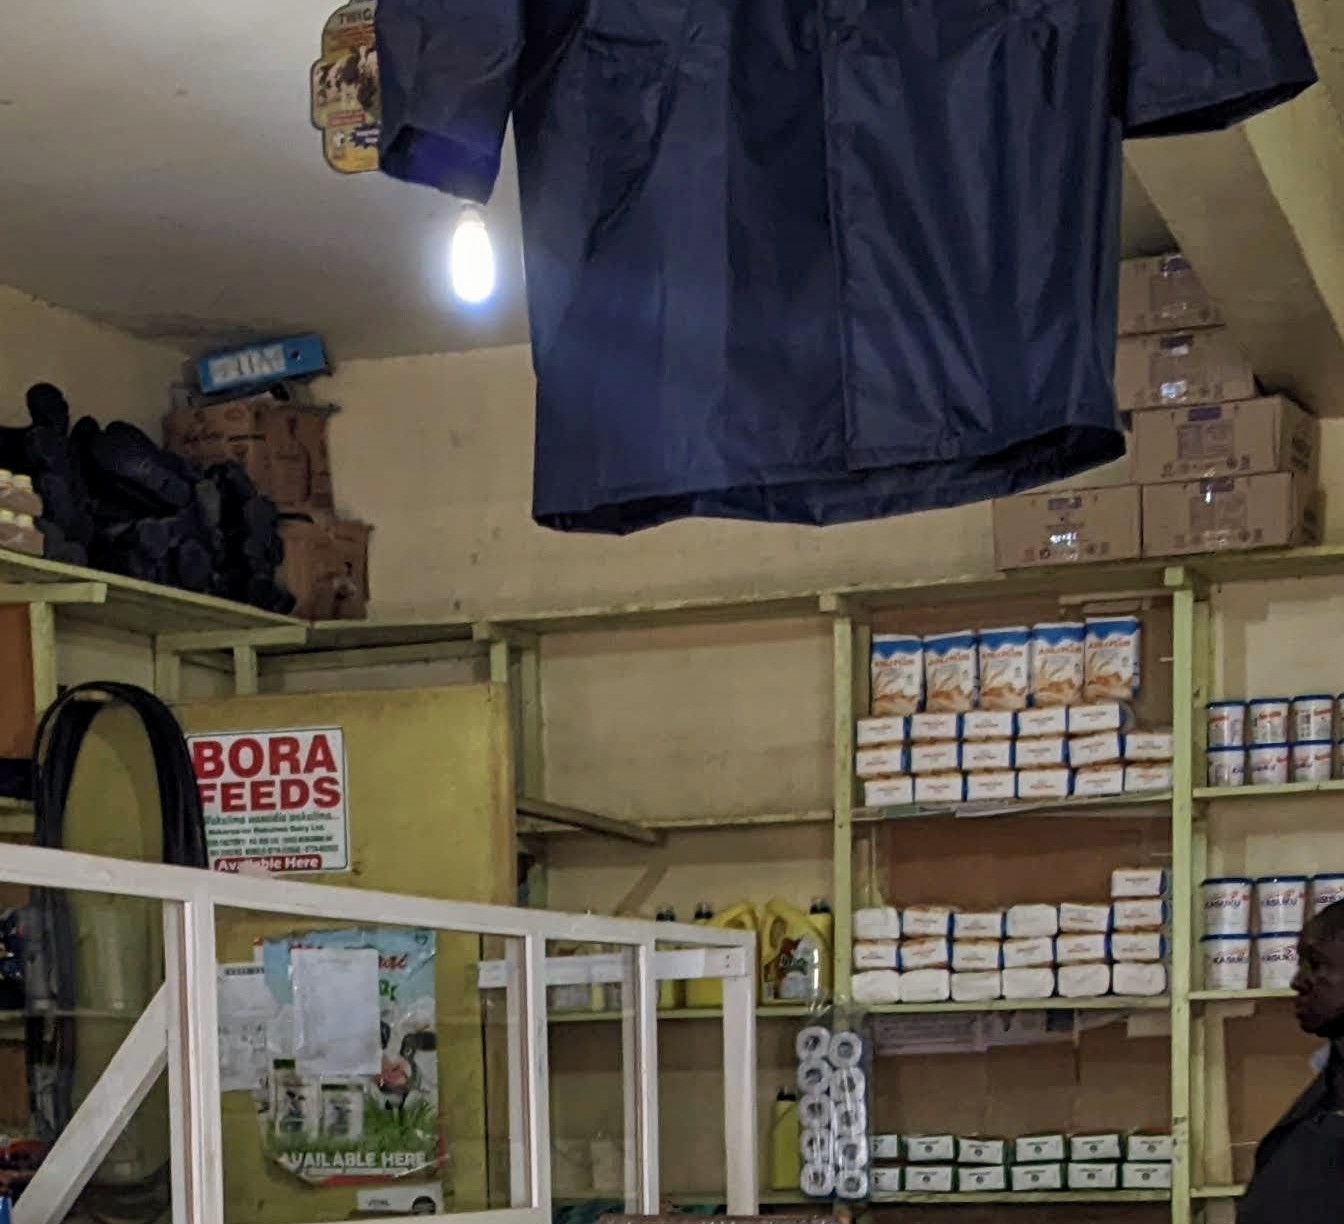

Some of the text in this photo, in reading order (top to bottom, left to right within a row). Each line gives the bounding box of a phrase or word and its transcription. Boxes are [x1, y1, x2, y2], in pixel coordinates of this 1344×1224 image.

[193, 734, 337, 779] BORA
[285, 855, 319, 869] Here
[381, 1151, 426, 1168] HERE
